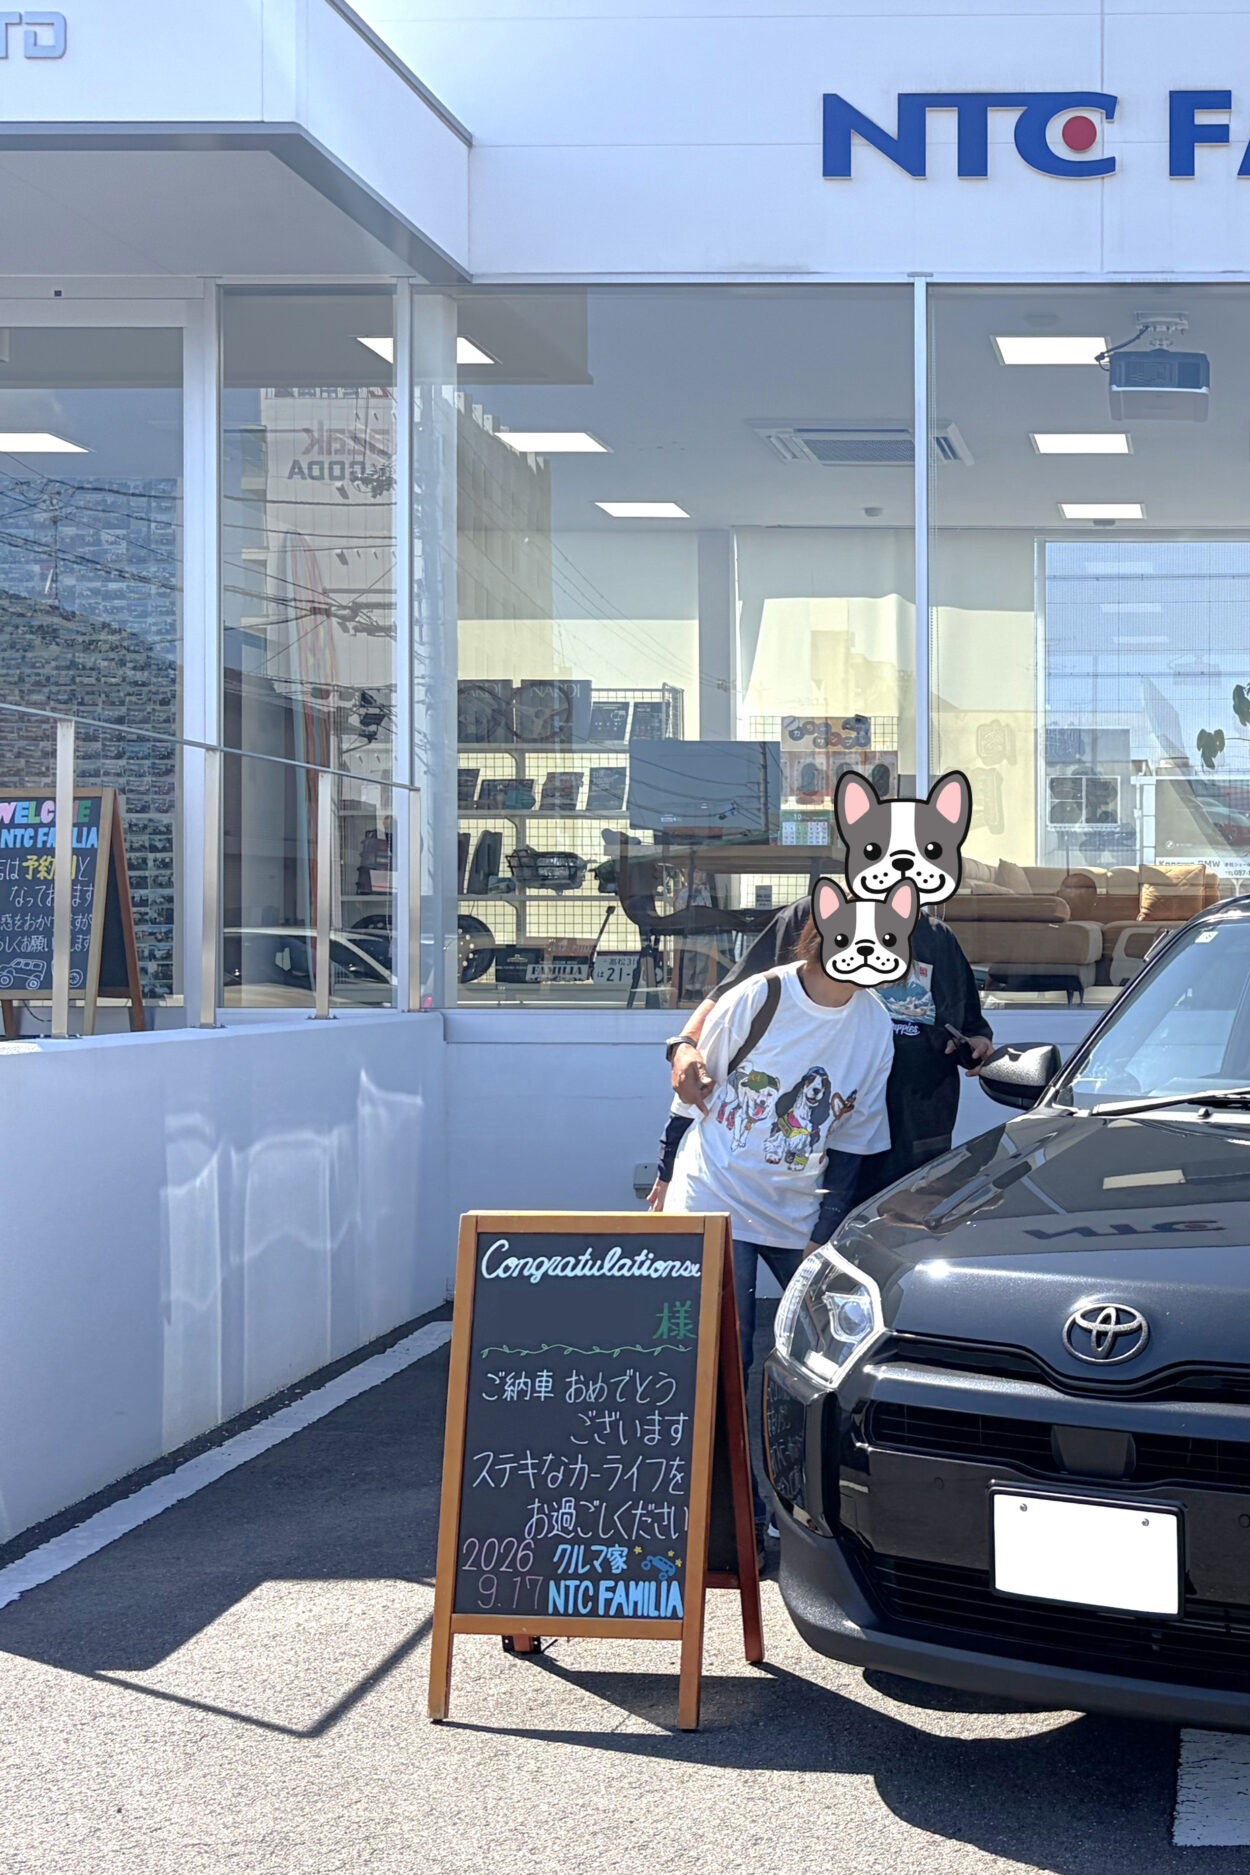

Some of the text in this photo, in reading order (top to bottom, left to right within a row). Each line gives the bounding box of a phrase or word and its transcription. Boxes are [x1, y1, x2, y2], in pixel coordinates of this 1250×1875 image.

[822, 91, 1118, 179] NTC
[0, 800, 92, 825] WELCE
[1, 826, 98, 849] NTC FALIA
[10, 882, 94, 908] なっておます
[531, 966, 583, 976] FAMILIA
[606, 967, 631, 982] 21-
[481, 1239, 700, 1284] Congratulations
[653, 1301, 698, 1340] 様
[482, 1369, 677, 1406] ご納車 おめでとう
[569, 1411, 689, 1446] ございます
[472, 1450, 686, 1495] ステキなカーライフを
[525, 1497, 689, 1541] お過ごしください
[461, 1537, 535, 1573] 2026
[553, 1544, 629, 1574] クルマ家
[548, 1579, 684, 1618] NTC FAMILIA
